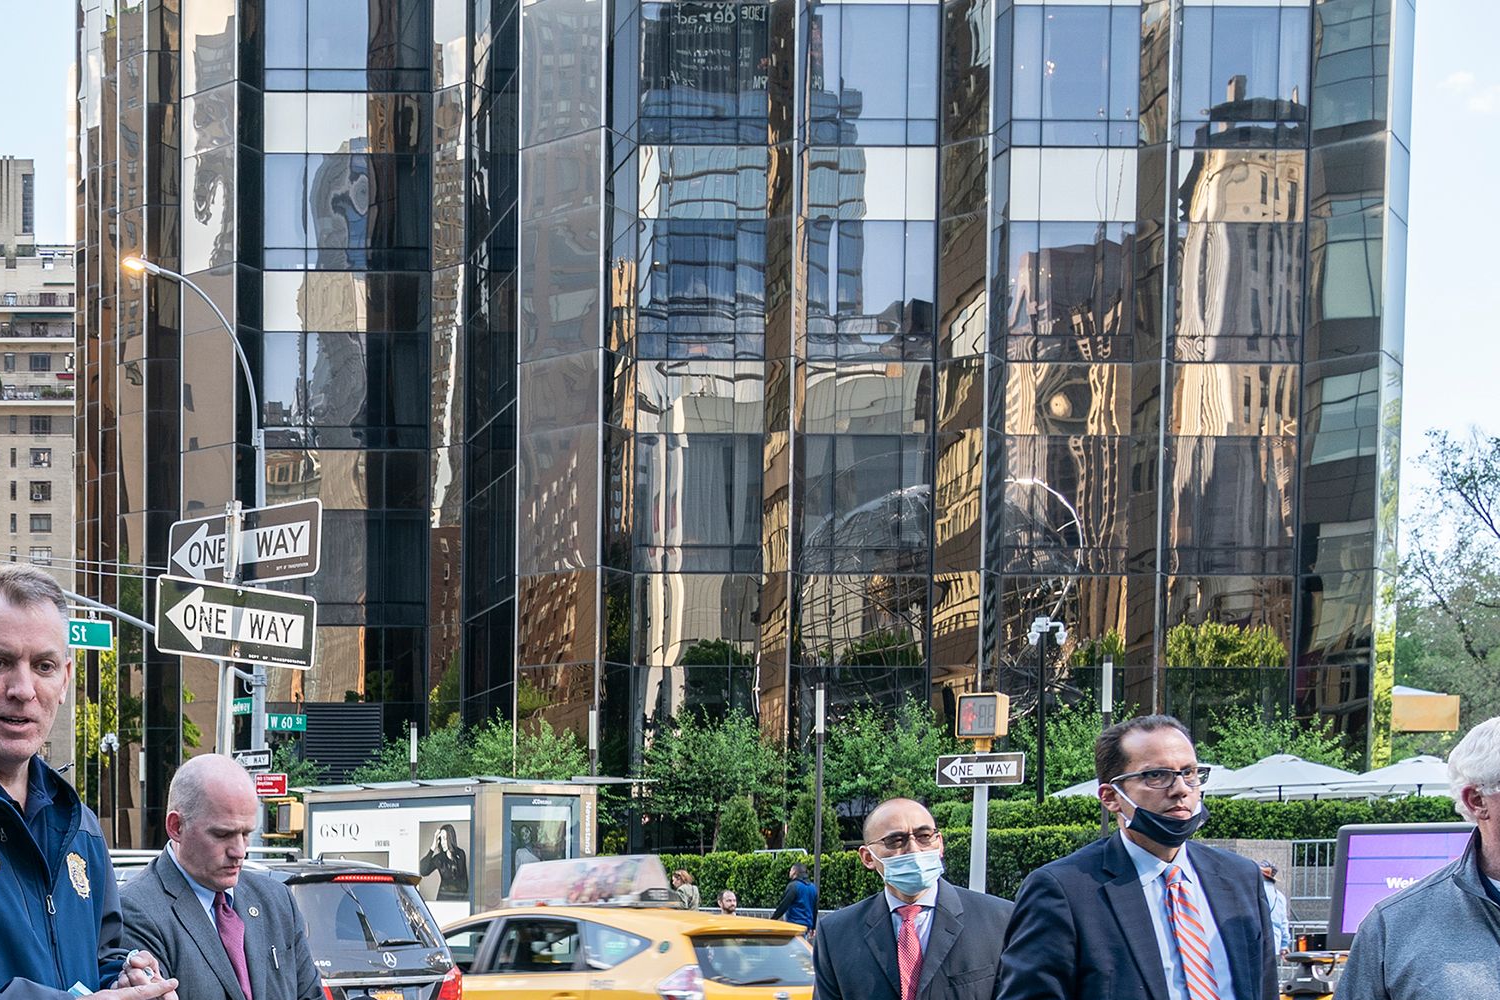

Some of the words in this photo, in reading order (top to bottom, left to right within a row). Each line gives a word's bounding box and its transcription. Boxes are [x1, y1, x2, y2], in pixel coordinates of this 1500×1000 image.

[188, 537, 226, 568] ONE
[255, 525, 305, 559] WAY
[183, 603, 227, 636] ONE
[249, 612, 295, 644] WAY
[71, 624, 88, 643] St
[270, 716, 278, 728] W
[280, 716, 293, 729] 60
[295, 717, 303, 725] St
[950, 764, 974, 777] ONE
[985, 763, 1012, 776] WAY
[319, 823, 360, 841] GSTQ
